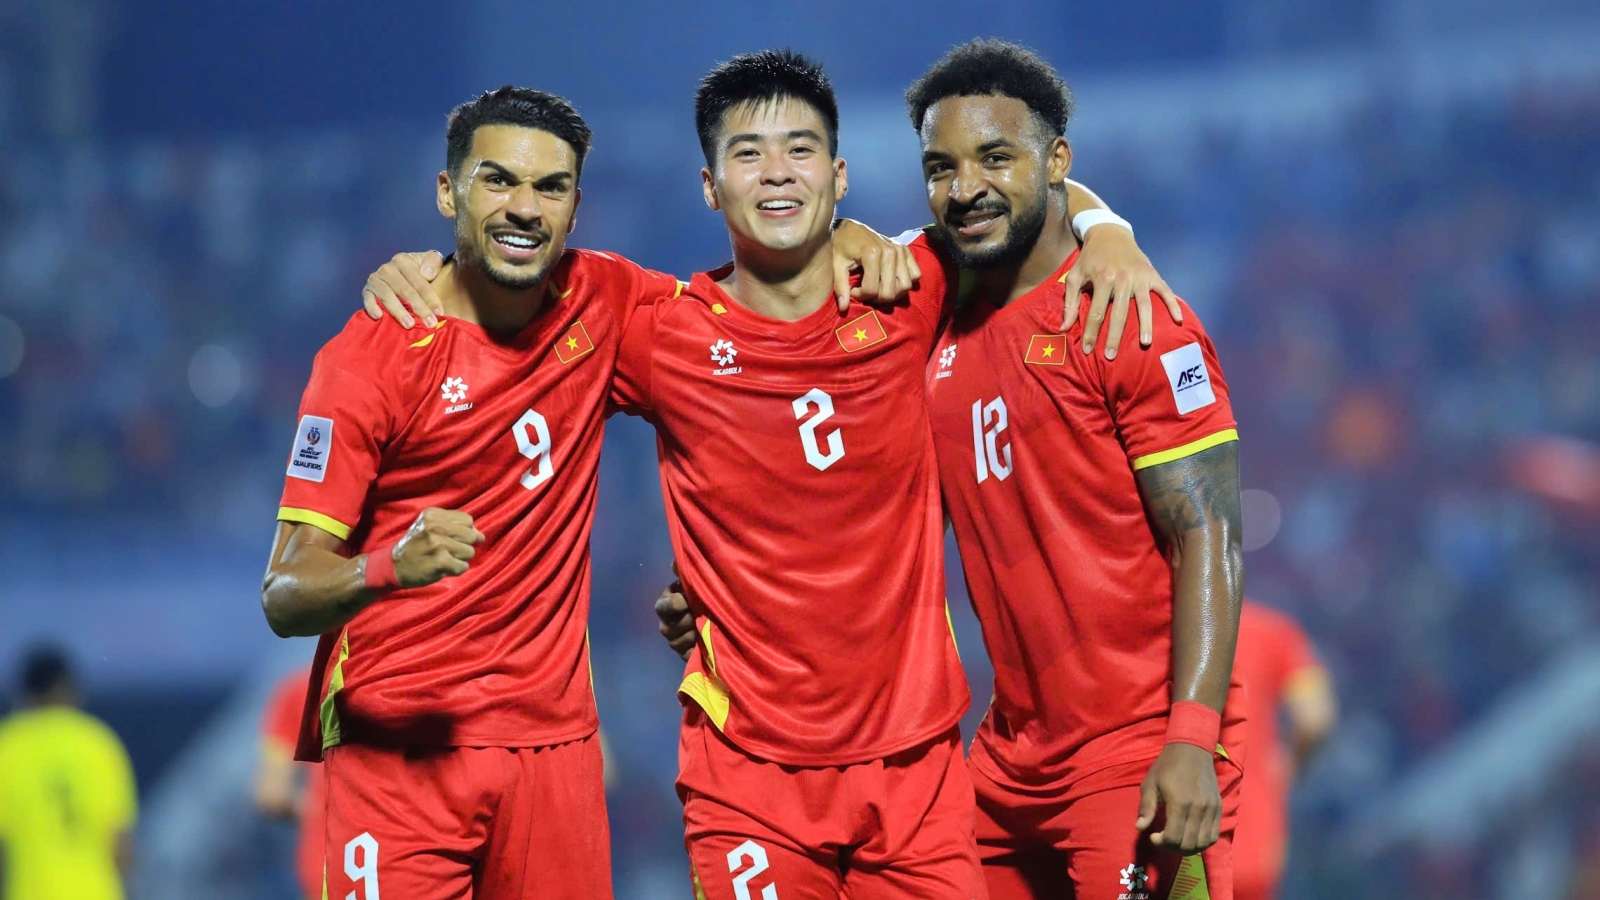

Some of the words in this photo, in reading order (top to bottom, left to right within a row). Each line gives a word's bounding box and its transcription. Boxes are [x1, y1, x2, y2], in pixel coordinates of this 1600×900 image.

[1177, 364, 1203, 388] AFC
[512, 408, 554, 490] 9
[792, 387, 845, 471] 2
[972, 395, 1013, 484] 12
[293, 460, 322, 471] QUALIFIERS
[344, 831, 380, 900] 9
[726, 839, 779, 900] 2
